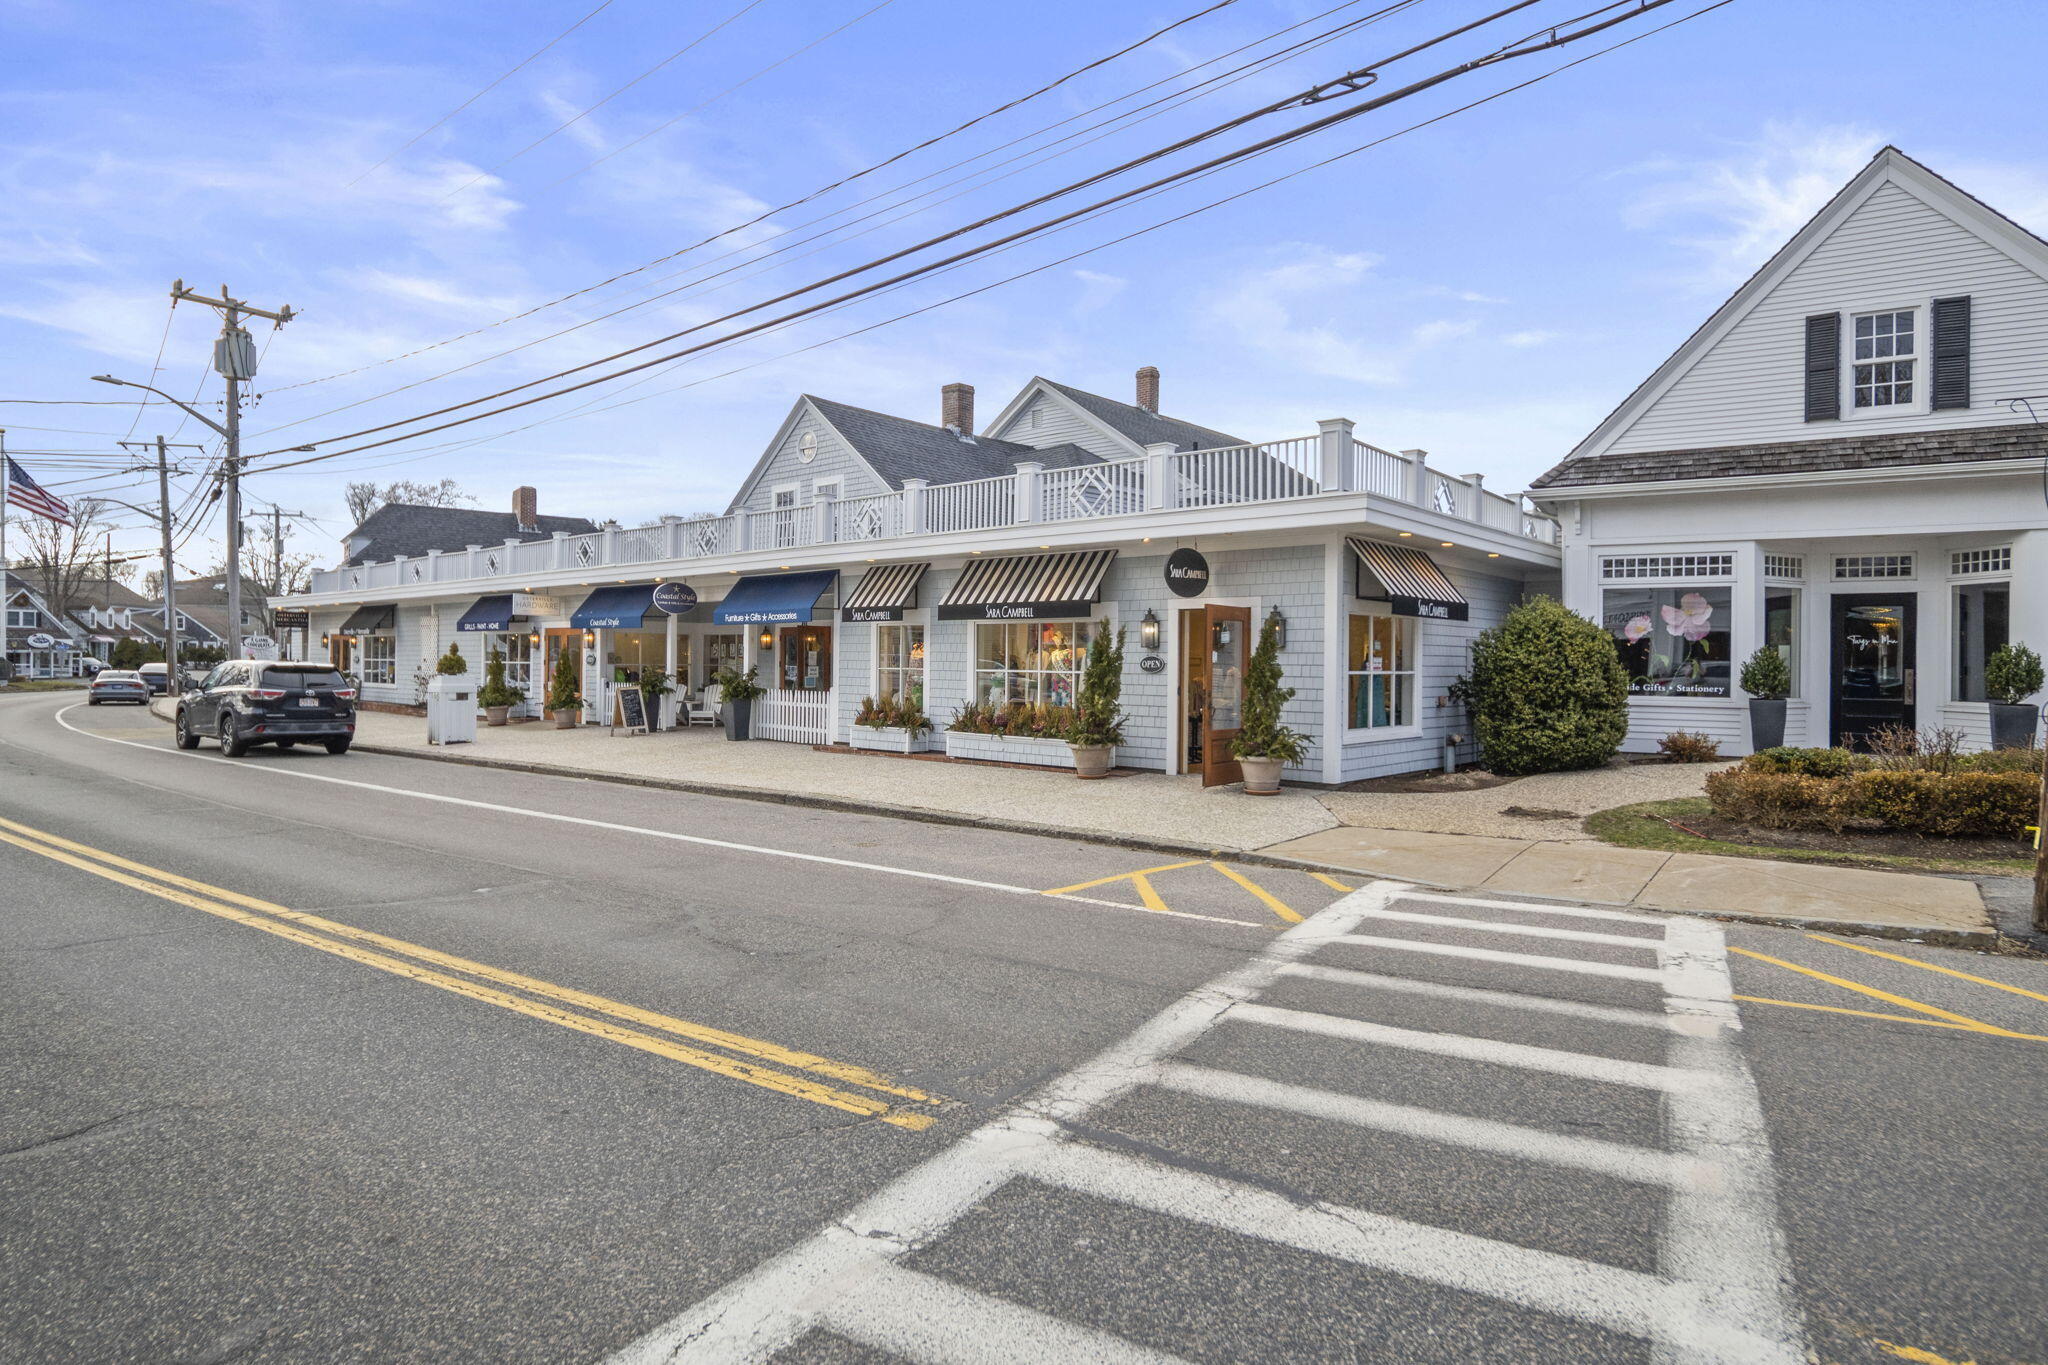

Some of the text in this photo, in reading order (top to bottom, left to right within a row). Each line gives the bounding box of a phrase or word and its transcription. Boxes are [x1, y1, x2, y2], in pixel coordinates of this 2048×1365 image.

[1183, 566, 1207, 580] CAMPBELL
[680, 593, 696, 602] Style
[516, 601, 559, 610] HARDWARE
[985, 604, 1034, 618] SARA CAMPBELL
[724, 612, 797, 622] Furniture Gifts Accessories
[852, 609, 890, 621] SARA CAMPBELL
[589, 617, 620, 628] Coastal Style
[1141, 660, 1160, 668] OPEN
[1642, 683, 1666, 692] Gifts
[1676, 684, 1725, 695] Stationery
